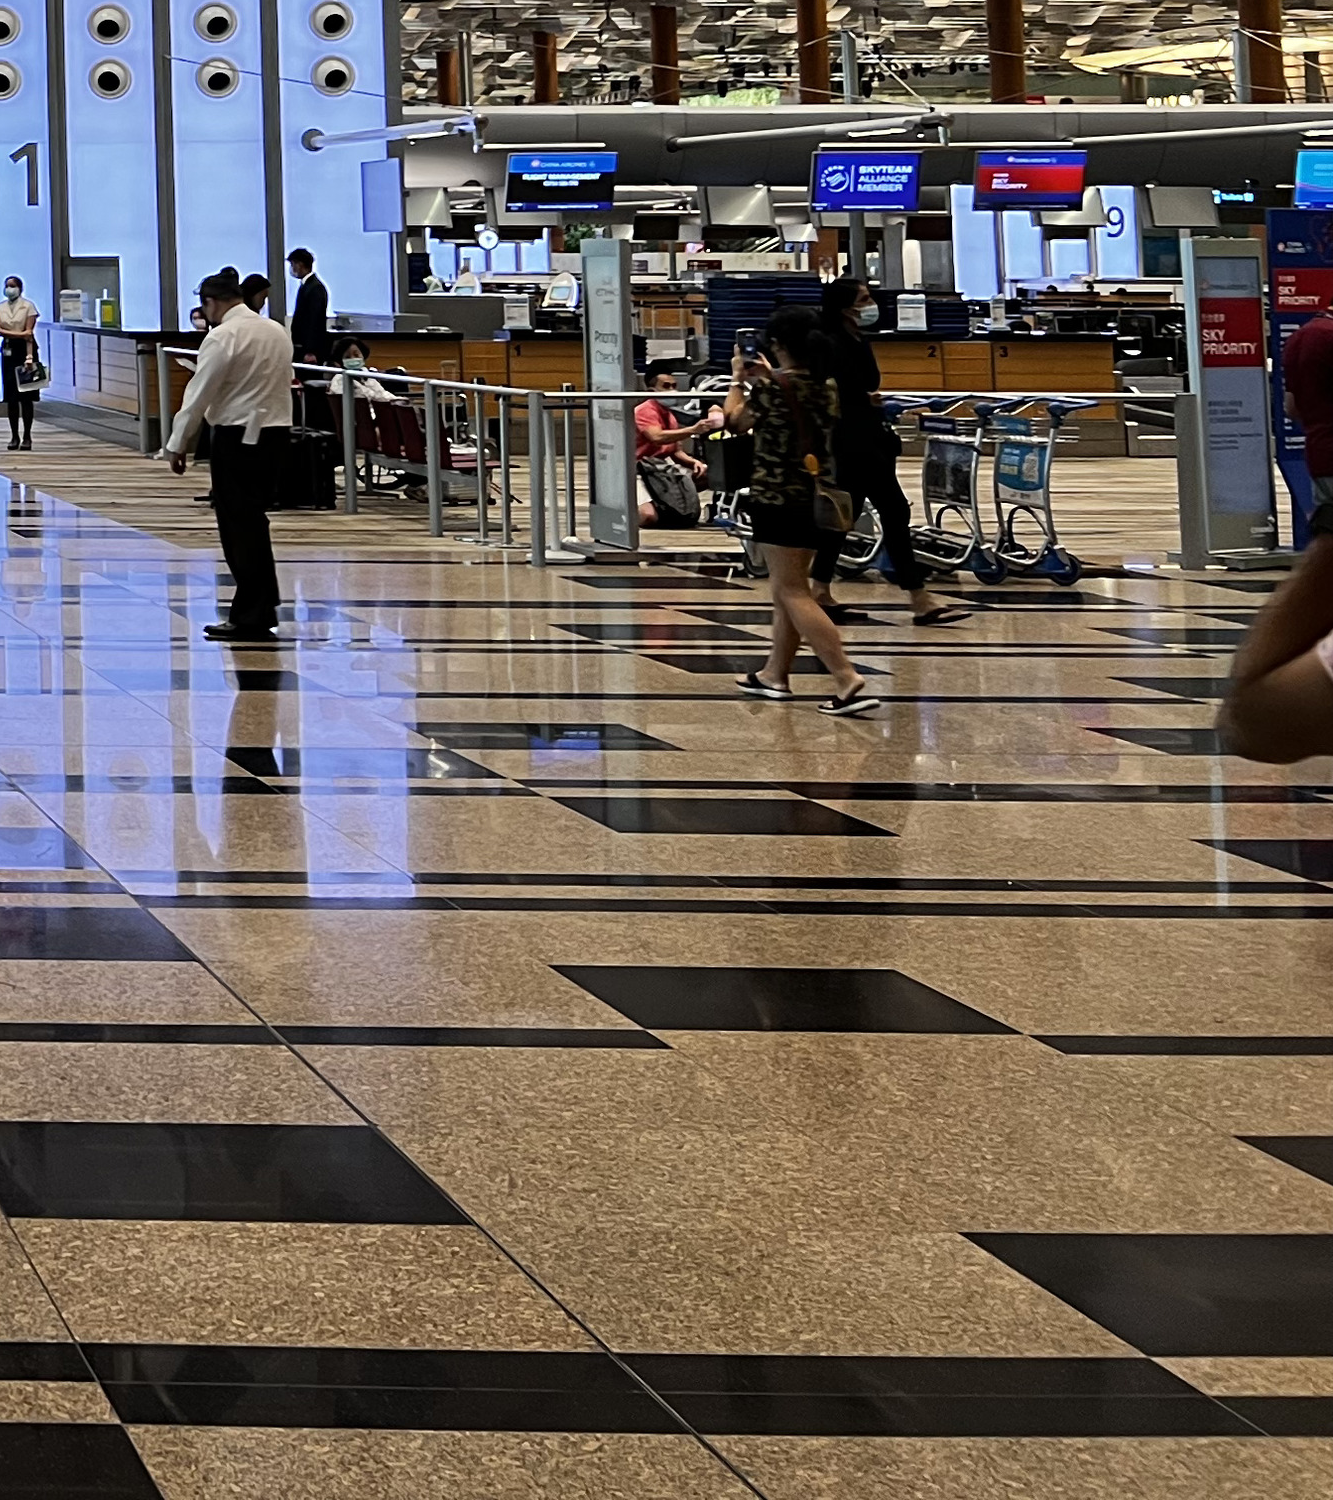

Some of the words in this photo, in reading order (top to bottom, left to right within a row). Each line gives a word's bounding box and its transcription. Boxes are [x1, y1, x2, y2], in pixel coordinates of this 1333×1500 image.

[859, 165, 913, 174] SKYTEAM
[858, 174, 909, 183] ALLIANCE
[857, 183, 903, 192] MEMBER
[1107, 205, 1125, 238] 9
[1278, 286, 1297, 295] SKY
[1278, 296, 1321, 305] PRIORITY
[1202, 329, 1226, 341] SKY
[927, 345, 937, 357] 2
[999, 345, 1008, 357] 3
[1203, 343, 1258, 355] PRIORITY
